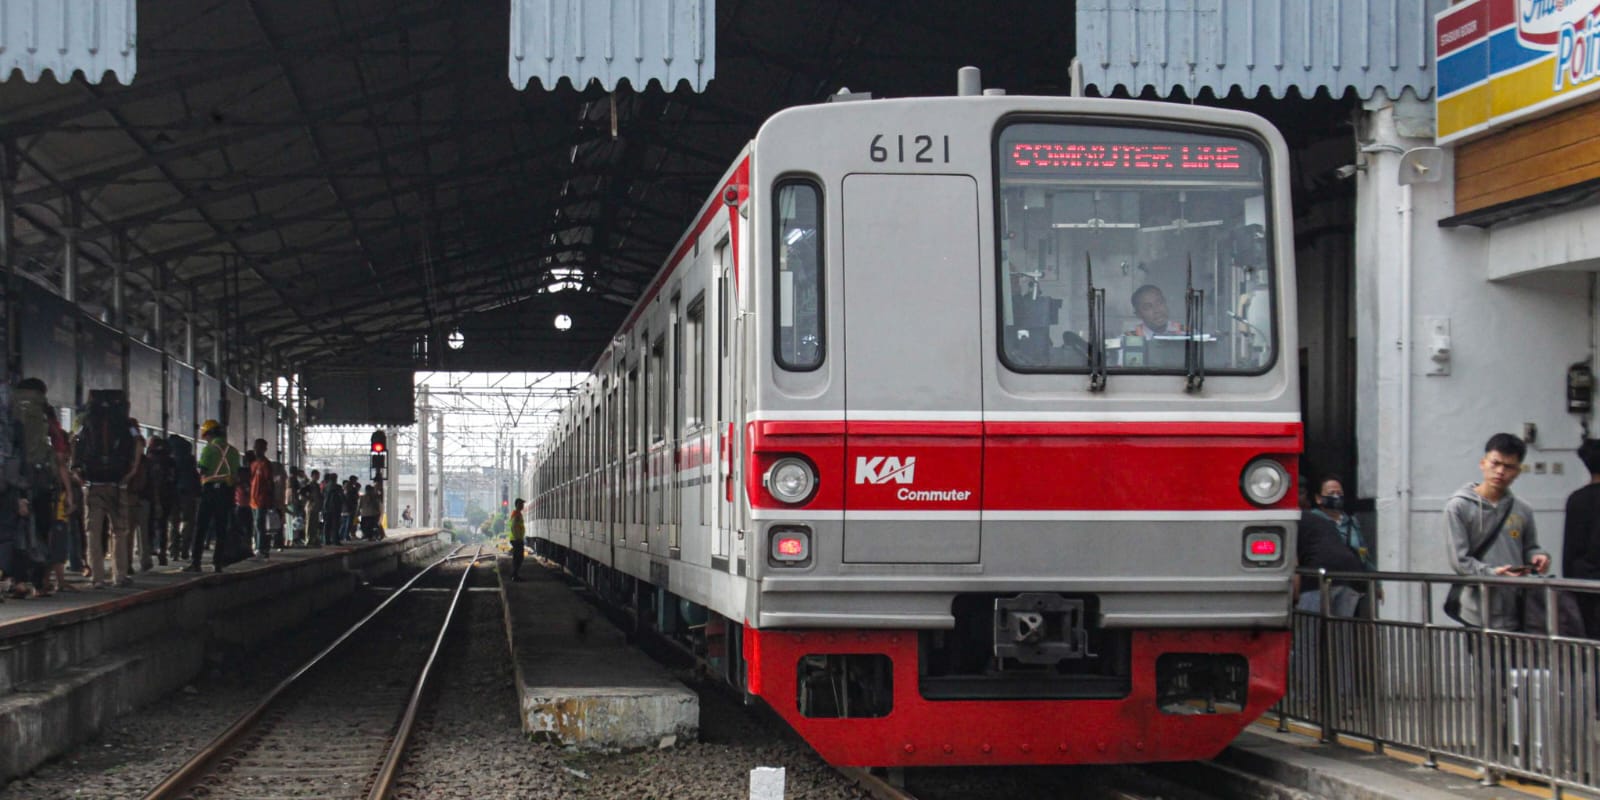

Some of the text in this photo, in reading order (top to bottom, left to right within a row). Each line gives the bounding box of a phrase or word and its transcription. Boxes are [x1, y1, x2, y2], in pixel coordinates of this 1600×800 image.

[870, 134, 950, 163] 6121
[1013, 144, 1240, 168] COMMUTER LINE
[855, 456, 916, 484] KAI
[897, 487, 971, 501] Commuter
